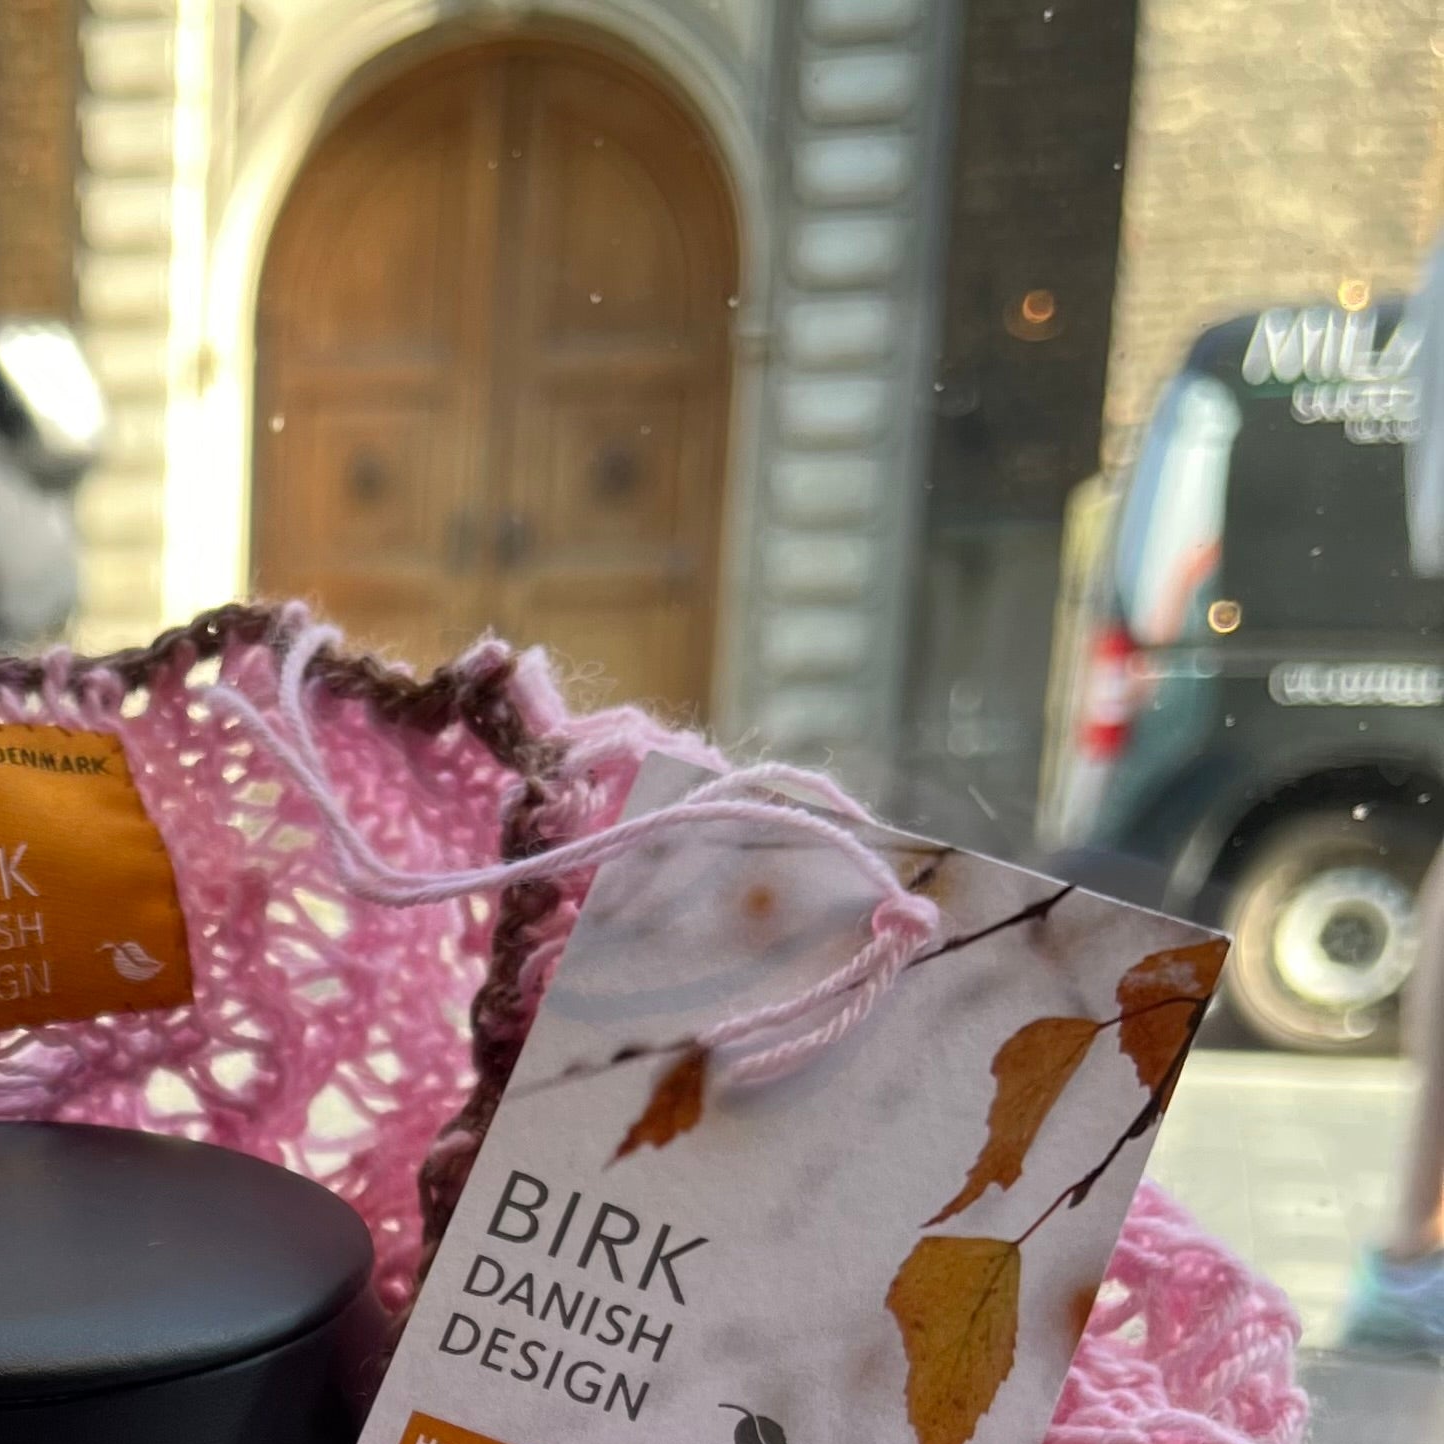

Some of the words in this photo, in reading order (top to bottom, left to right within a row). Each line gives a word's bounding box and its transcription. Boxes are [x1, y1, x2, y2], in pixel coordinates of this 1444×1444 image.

[486, 1169, 709, 1306] BIRK
[461, 1253, 674, 1363] DANISH
[438, 1311, 651, 1422] DESIGN
